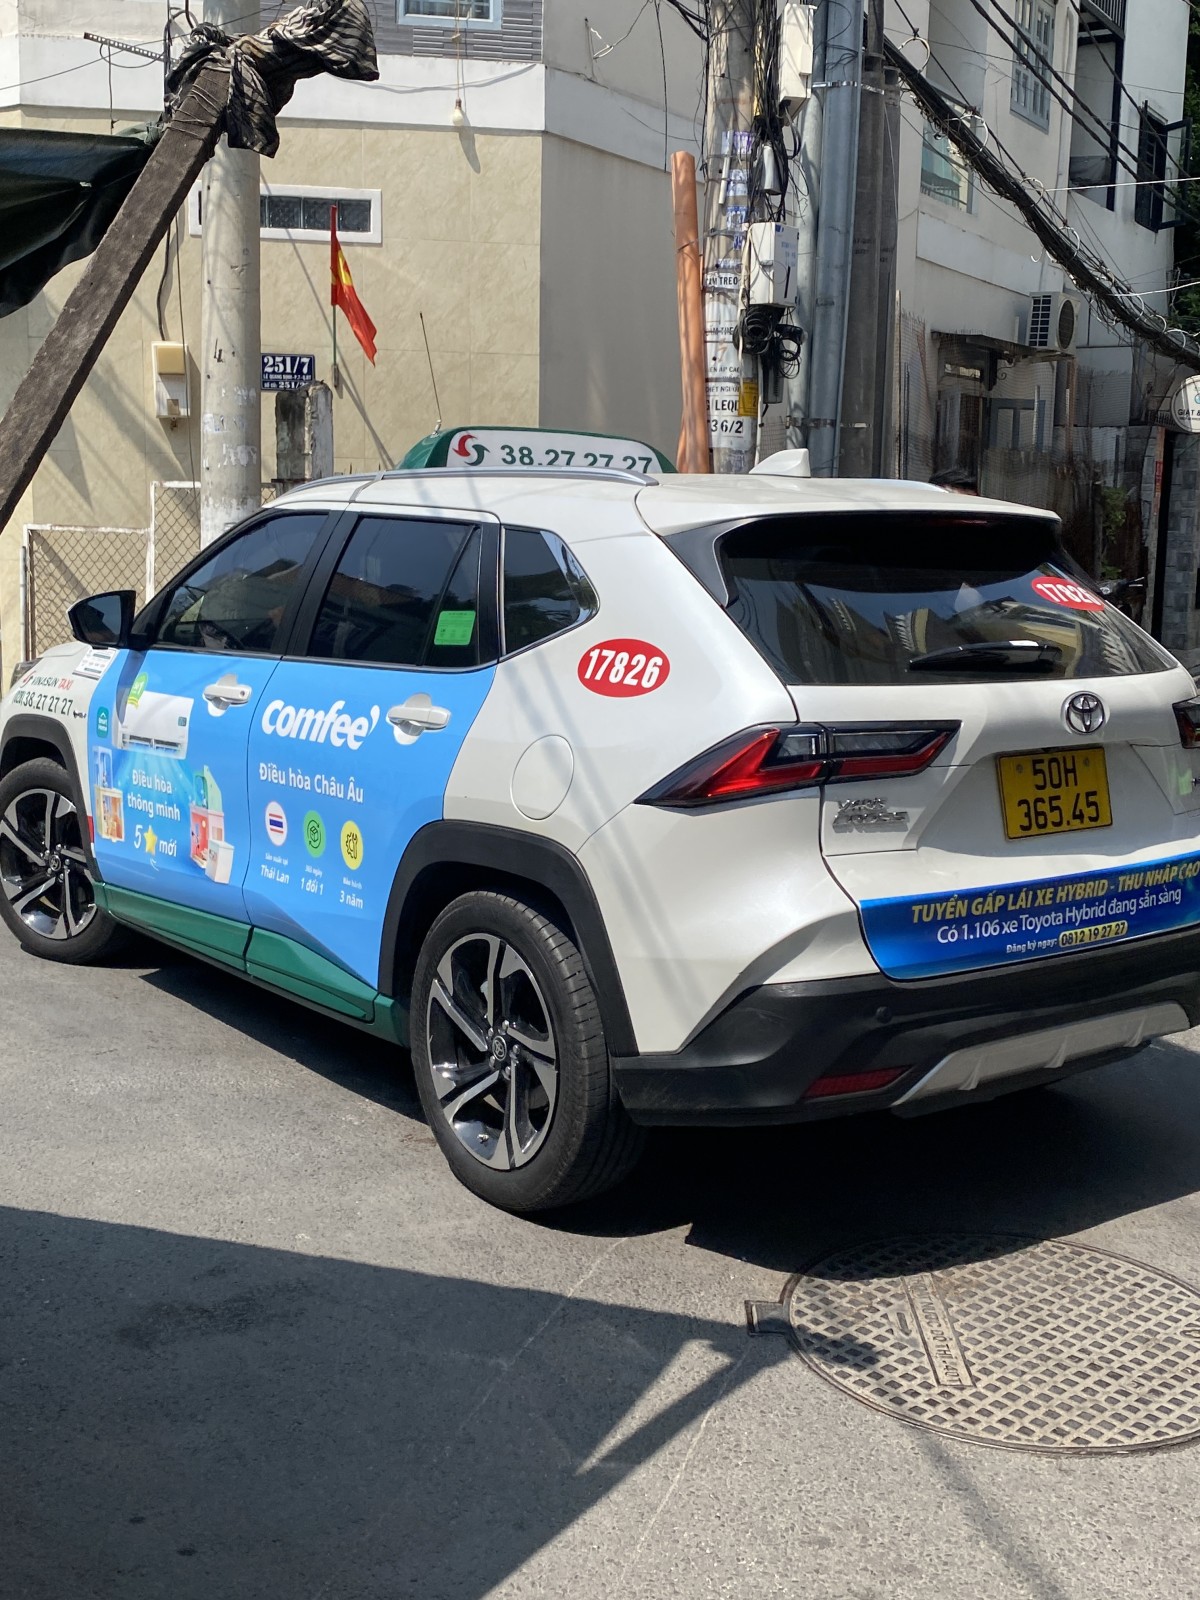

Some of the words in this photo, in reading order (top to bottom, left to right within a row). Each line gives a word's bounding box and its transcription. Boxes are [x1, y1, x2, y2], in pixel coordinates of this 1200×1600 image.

[720, 276, 738, 285] TREO
[264, 356, 310, 374] 251/7
[584, 648, 664, 689] 17826
[58, 678, 74, 690] TAXI
[48, 696, 60, 713] 27
[60, 698, 73, 716] 27
[132, 769, 152, 788] Điều
[154, 774, 172, 794] hòa
[259, 762, 286, 785] Điều
[289, 768, 311, 790] hòa
[314, 774, 344, 798] Châu
[347, 776, 364, 803] Âu
[1032, 755, 1078, 790] 50H
[128, 792, 154, 818] thông
[156, 801, 180, 821] minh
[1017, 790, 1100, 831] 365.45
[134, 824, 143, 848] 5
[159, 838, 177, 857] mới
[261, 864, 275, 879] Thái
[276, 870, 290, 884] Lan
[340, 890, 344, 902] 3
[346, 894, 363, 909] năm
[912, 894, 968, 923] TUYỂN
[971, 890, 1005, 916] GẤP
[1007, 888, 1033, 911] LÁI
[1034, 888, 1054, 907] XE
[1056, 879, 1108, 904] HYBRID
[1118, 872, 1144, 892] THU
[1178, 861, 1200, 879] CAO
[937, 924, 958, 943] Có
[962, 920, 1000, 940] 1.106
[1002, 920, 1018, 935] xe
[1020, 911, 1063, 933] Toyota
[1066, 900, 1106, 926] Hybrid
[1108, 898, 1137, 915] đang
[1139, 890, 1157, 908] sẵn
[1158, 885, 1181, 904] sàng
[1006, 943, 1026, 953] Đăng
[1061, 930, 1086, 946] 0812
[1088, 927, 1099, 940] 19
[1100, 925, 1112, 938] 27
[1114, 922, 1125, 935] 27
